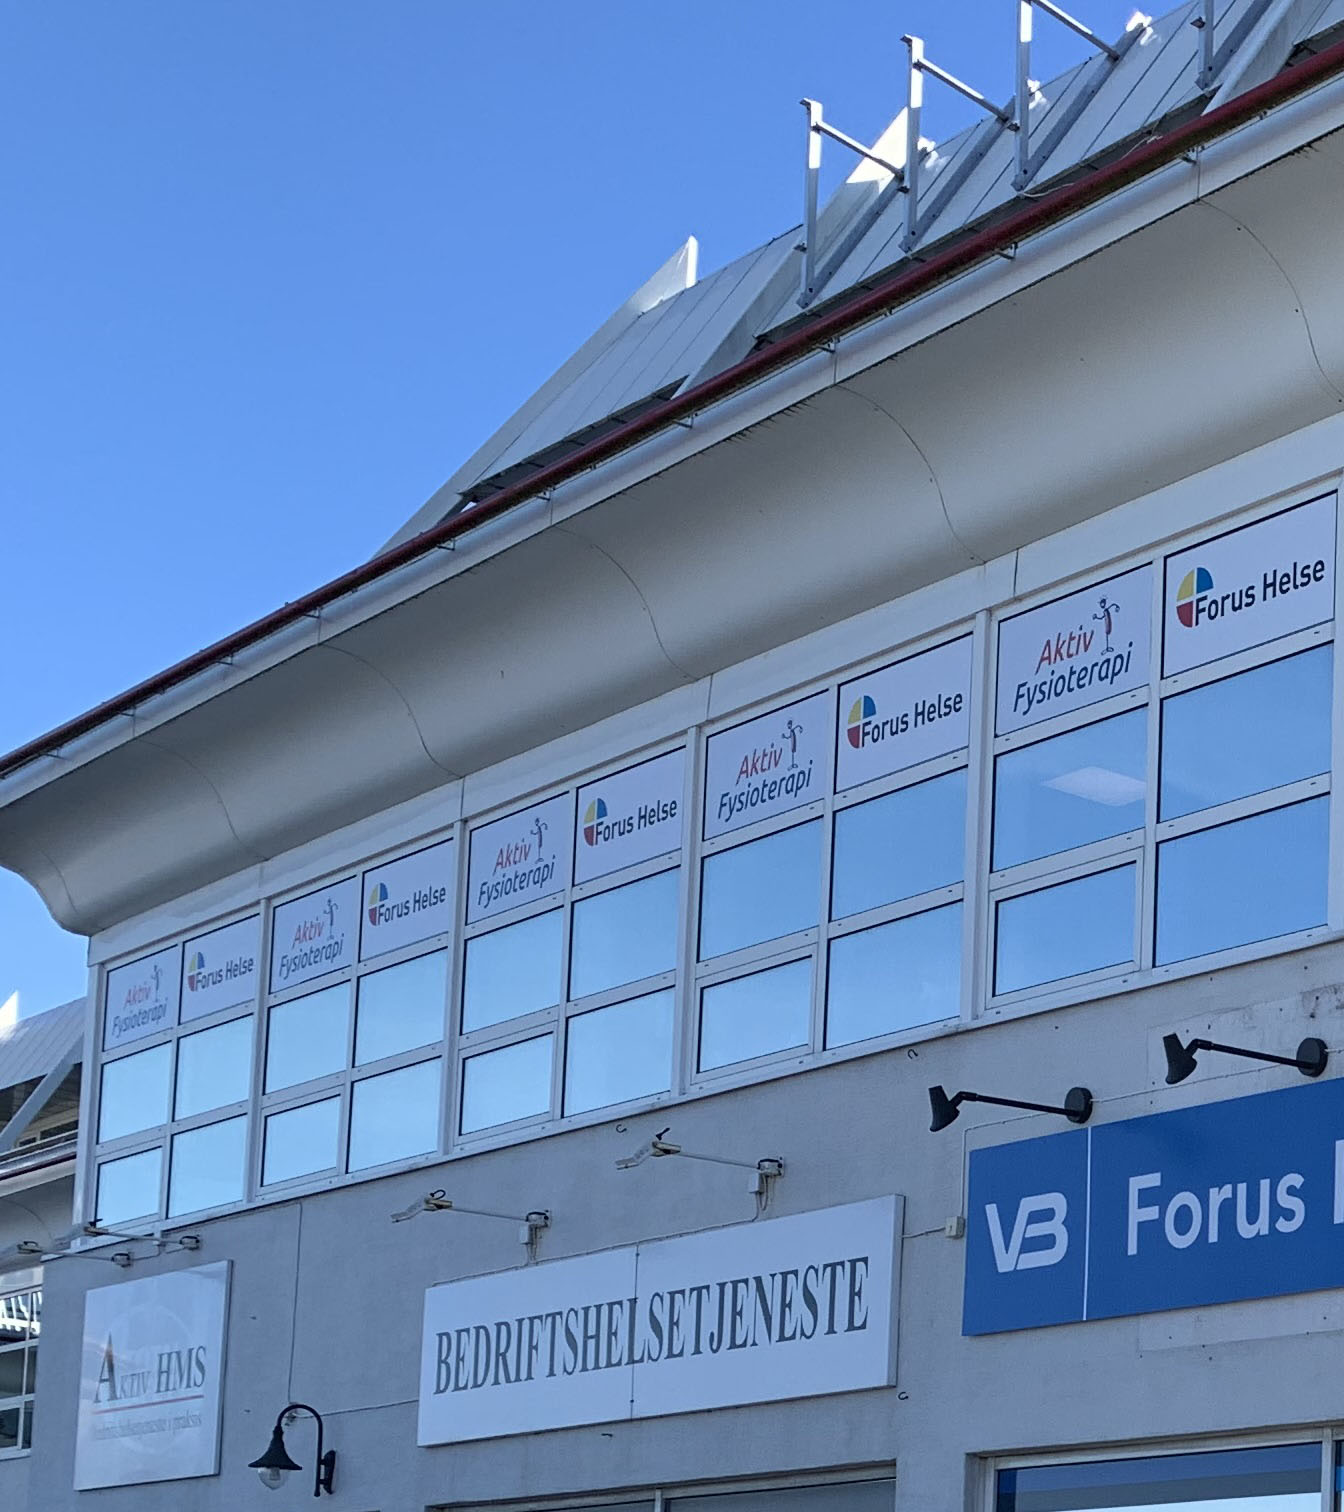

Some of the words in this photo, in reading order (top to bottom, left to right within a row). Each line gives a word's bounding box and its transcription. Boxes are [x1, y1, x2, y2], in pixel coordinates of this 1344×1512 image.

[1195, 586, 1256, 626] Forus
[1262, 559, 1325, 601] Helse
[1035, 625, 1095, 674] Aktiv
[1013, 642, 1133, 715] Fysioterapi
[861, 714, 909, 748] Forus
[914, 693, 963, 728] Helse
[736, 743, 782, 785] Aktiv
[718, 760, 813, 822] Fysioterapi
[595, 816, 634, 846] Forus
[637, 800, 678, 830] Helse
[477, 855, 556, 909] Fysioterapi
[492, 838, 532, 876] Aktiv
[377, 901, 410, 925] Forus
[412, 886, 447, 913] Helse
[279, 933, 345, 980] Fysioterapi
[292, 918, 325, 948] Aktiv
[985, 1192, 1069, 1273] VB
[1127, 1172, 1306, 1256] Forus
[433, 1256, 870, 1395] BEDRIFTSHELSETJENESTE
[155, 1346, 206, 1393] HMS
